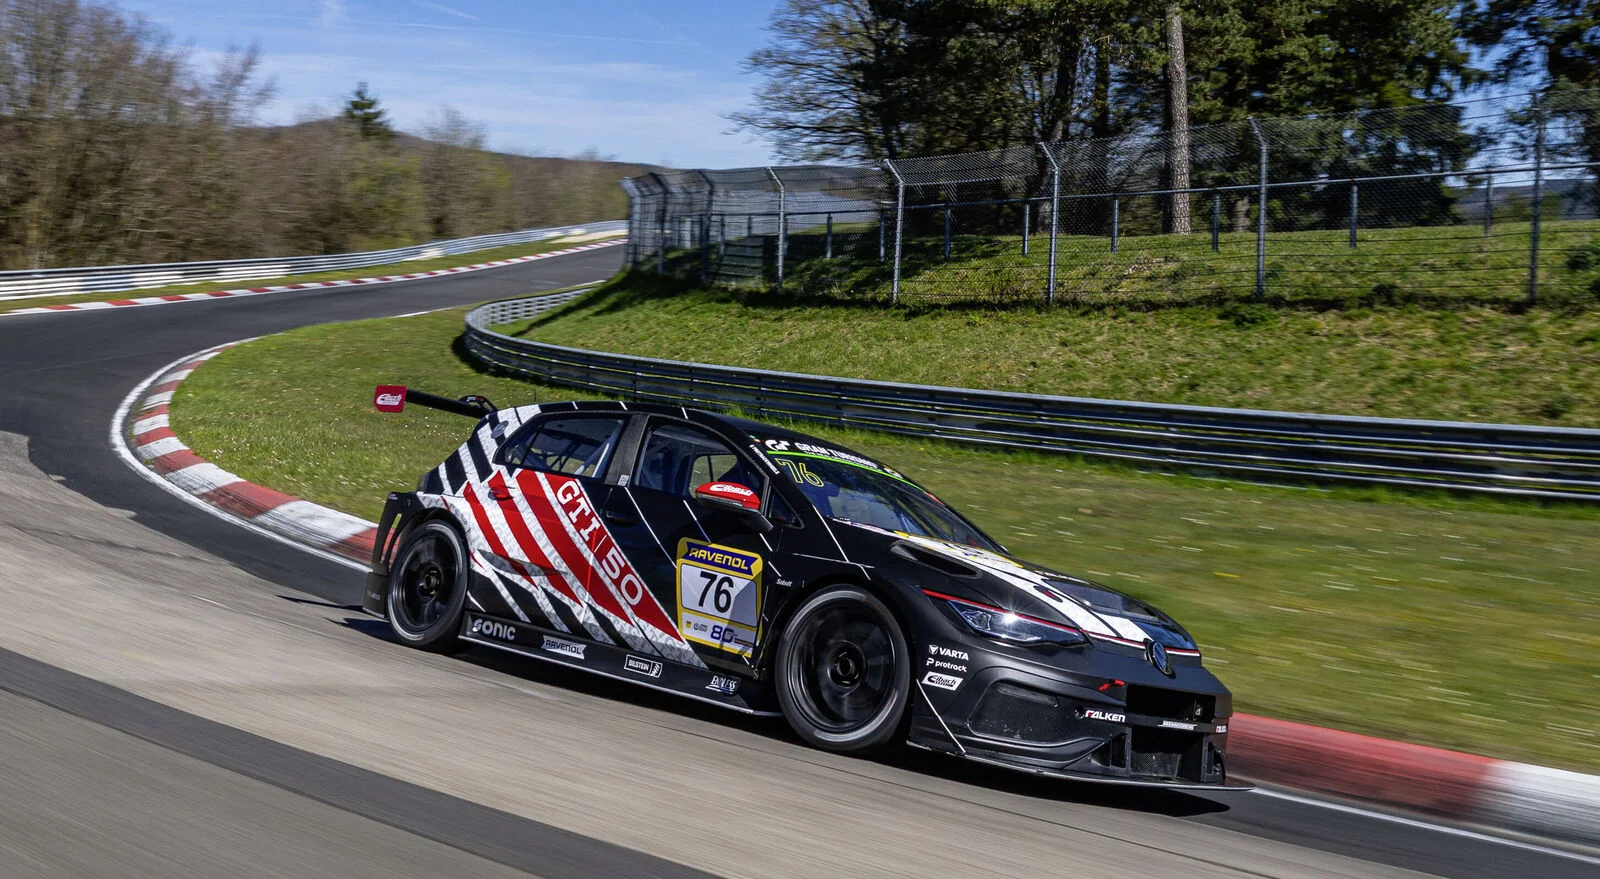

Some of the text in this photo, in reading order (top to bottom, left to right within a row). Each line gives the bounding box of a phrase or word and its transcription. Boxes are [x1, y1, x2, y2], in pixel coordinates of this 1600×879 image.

[794, 442, 831, 456] GRAN
[774, 458, 825, 487] 76
[556, 480, 643, 606] GTI 50
[689, 547, 748, 570] RAVENOL
[698, 571, 734, 613] 76
[472, 618, 516, 640] SONIC
[545, 640, 581, 654] RAVENOL
[939, 647, 969, 661] VARTA
[627, 660, 650, 671] BILSTEIN
[935, 661, 967, 673] protrack
[1085, 709, 1126, 722] FALKEN
